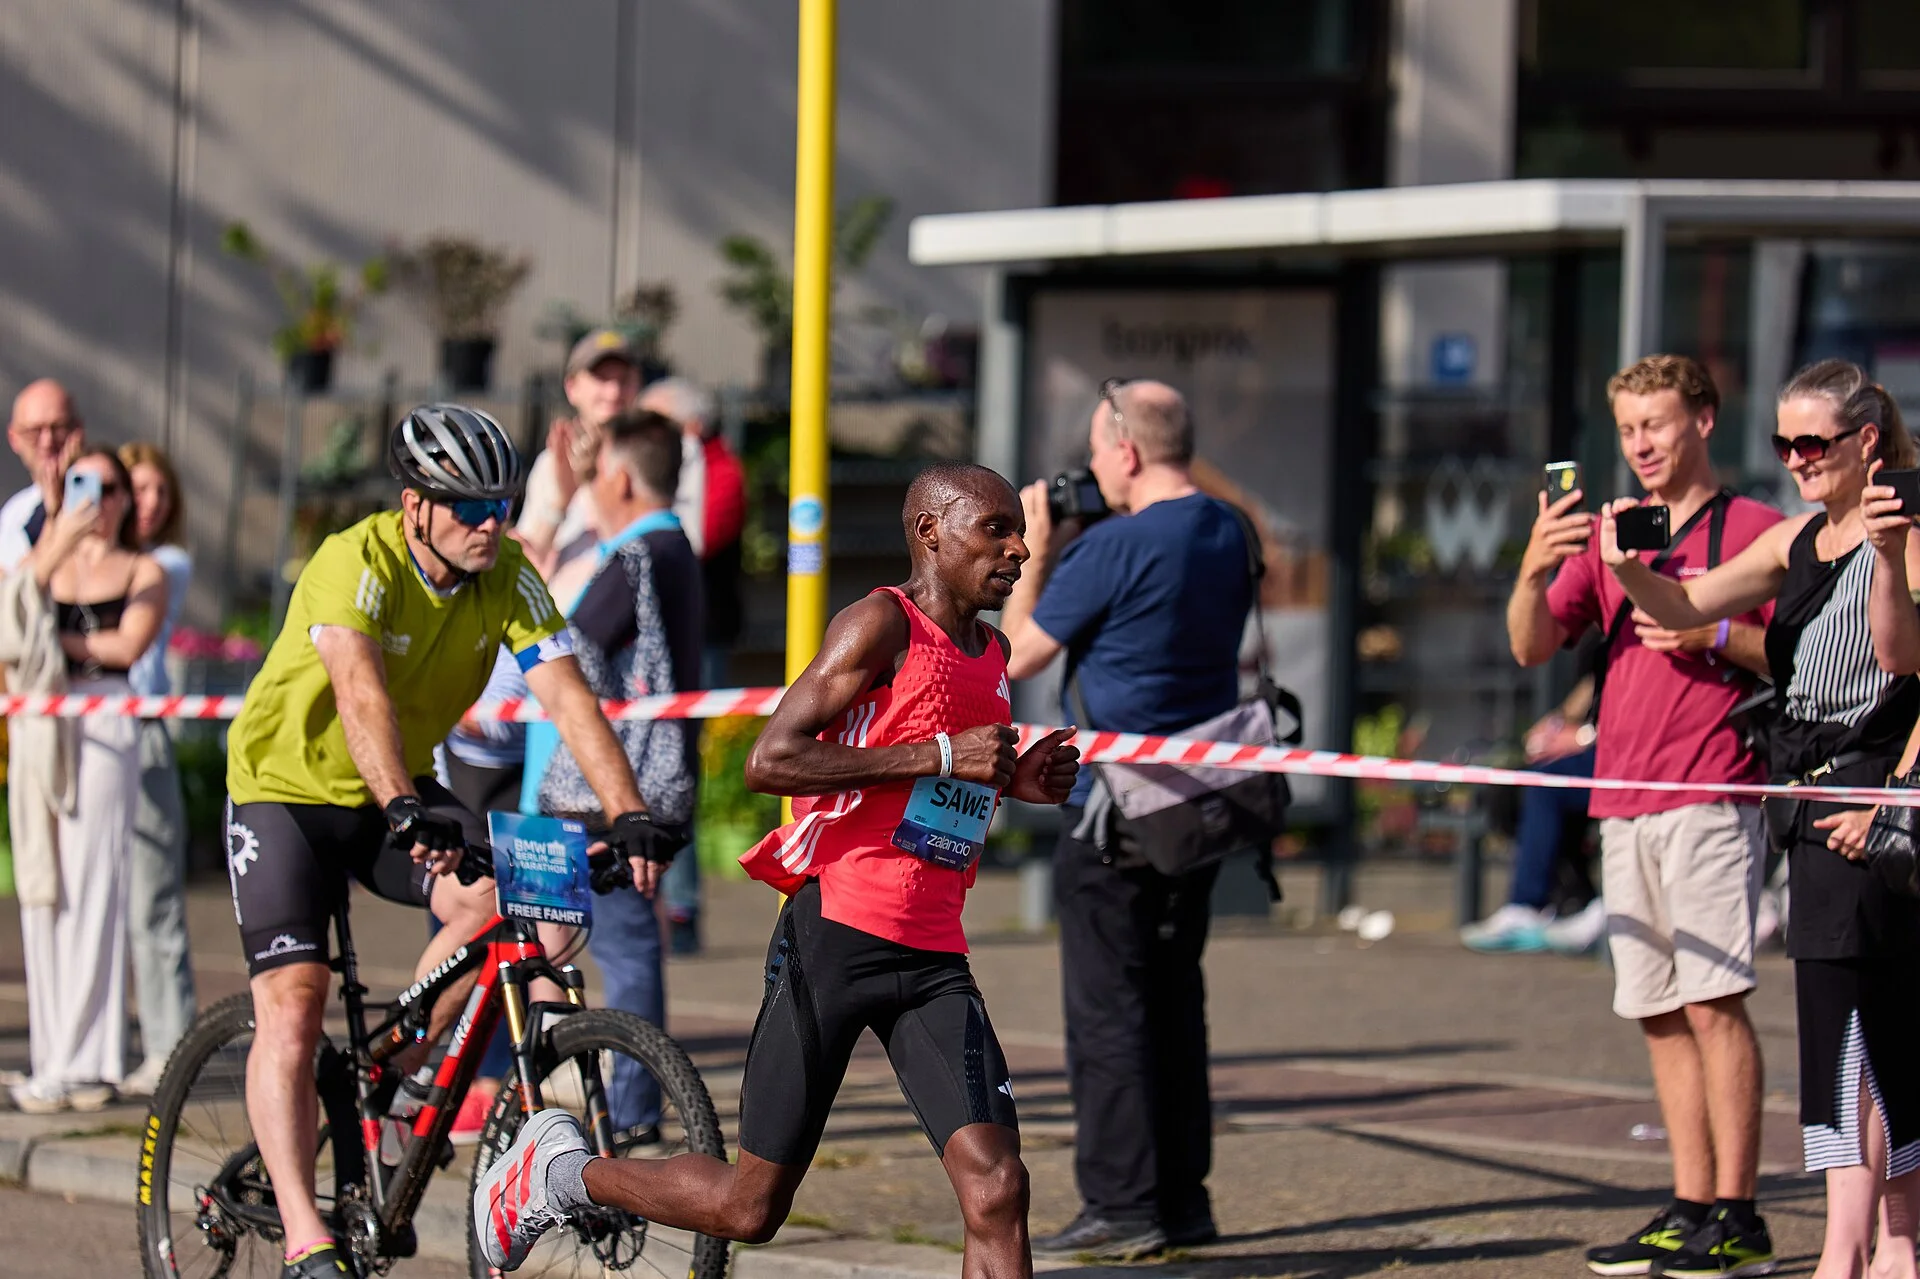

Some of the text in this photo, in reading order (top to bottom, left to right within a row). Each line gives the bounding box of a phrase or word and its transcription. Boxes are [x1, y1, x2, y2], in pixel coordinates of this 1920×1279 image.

[930, 781, 991, 821] SAWE
[953, 820, 959, 828] 3
[514, 838, 546, 854] BMW
[927, 834, 971, 857] zalando
[515, 851, 548, 863] BERLIN
[507, 902, 585, 924] FREIE FAHRT
[398, 945, 468, 1007] ROTWILD
[139, 1115, 161, 1206] MAXXIS
